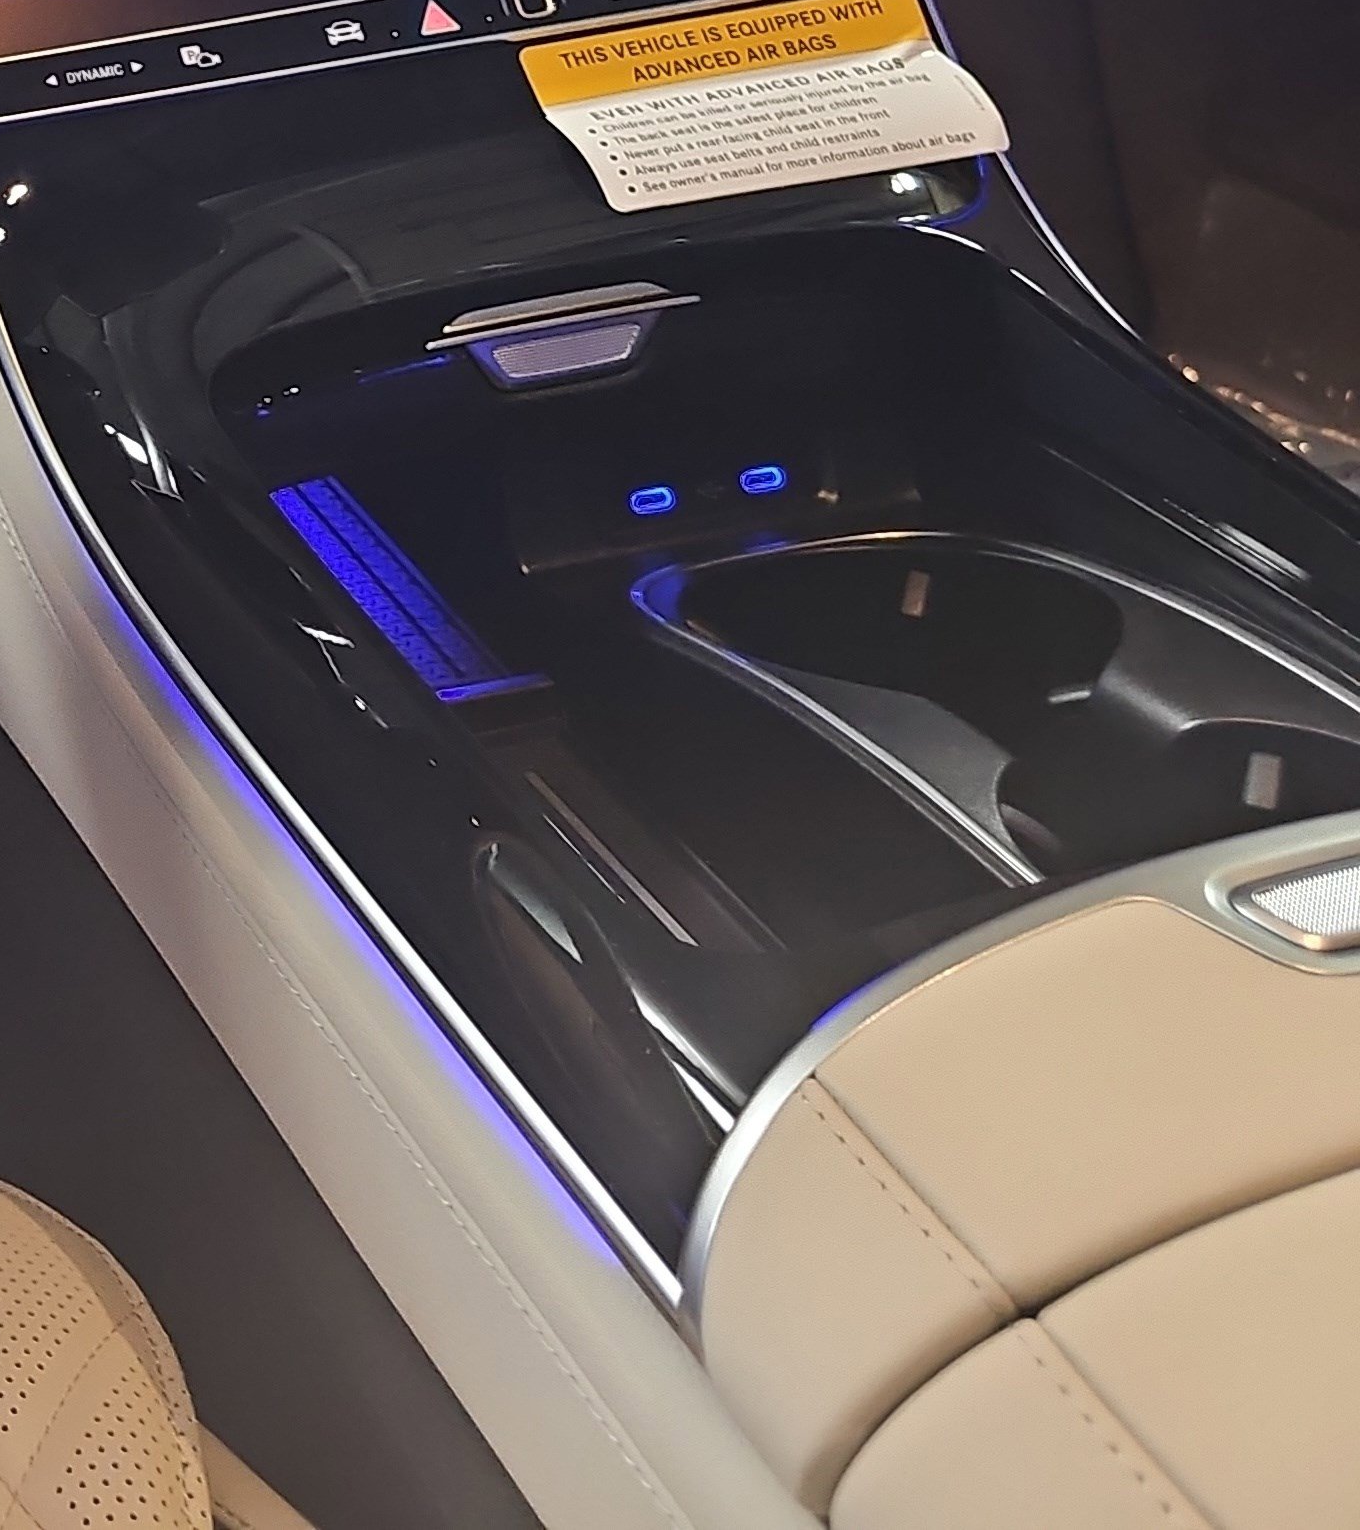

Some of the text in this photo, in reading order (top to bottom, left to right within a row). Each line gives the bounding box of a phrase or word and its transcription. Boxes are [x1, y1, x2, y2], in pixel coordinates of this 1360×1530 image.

[558, 0, 884, 69] THIS VEHICLE IS EQUIPPED WITH
[633, 34, 837, 83] ADVANCED AIR BAGS
[65, 64, 125, 86] DYNAMIC
[589, 57, 906, 122] EVEN WITH ADVANCED AIR BAGS
[602, 72, 931, 133] Children can be killed or seriously injured by the air bag
[612, 95, 878, 147] The back seat is the safest place for children
[623, 147, 661, 161] Never
[663, 143, 686, 157] put
[696, 138, 721, 149] rear
[722, 129, 764, 144] facing
[762, 123, 794, 138] child
[794, 119, 825, 133] seat
[824, 116, 837, 128] in
[837, 114, 859, 126] the
[858, 108, 891, 123] front
[634, 128, 882, 176] Always use seat belts and child restraints
[642, 130, 977, 194] See owner's manual for more information about air bags
